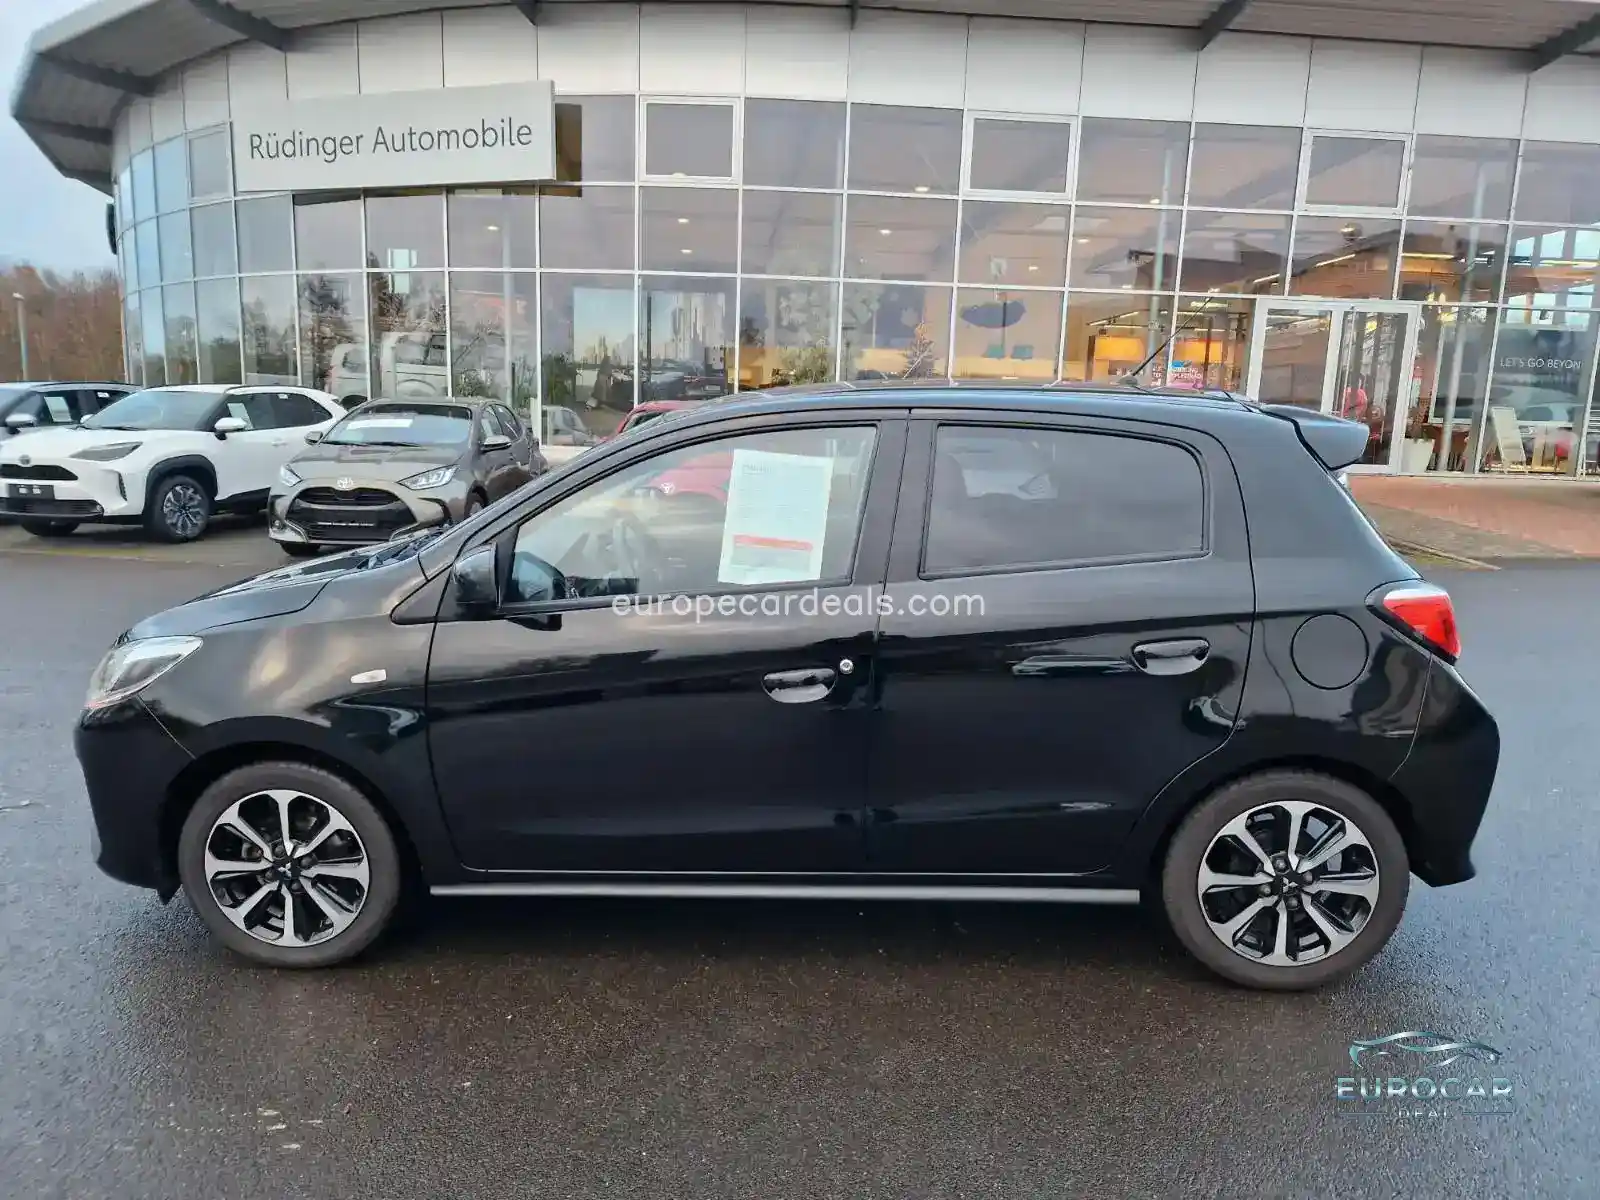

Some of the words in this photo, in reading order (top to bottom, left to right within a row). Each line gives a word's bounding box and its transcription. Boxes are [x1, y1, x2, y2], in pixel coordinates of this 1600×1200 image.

[250, 130, 363, 163] Rüdinger
[372, 116, 532, 153] Automobile
[1527, 358, 1545, 369] GO
[1547, 358, 1583, 370] BEYON
